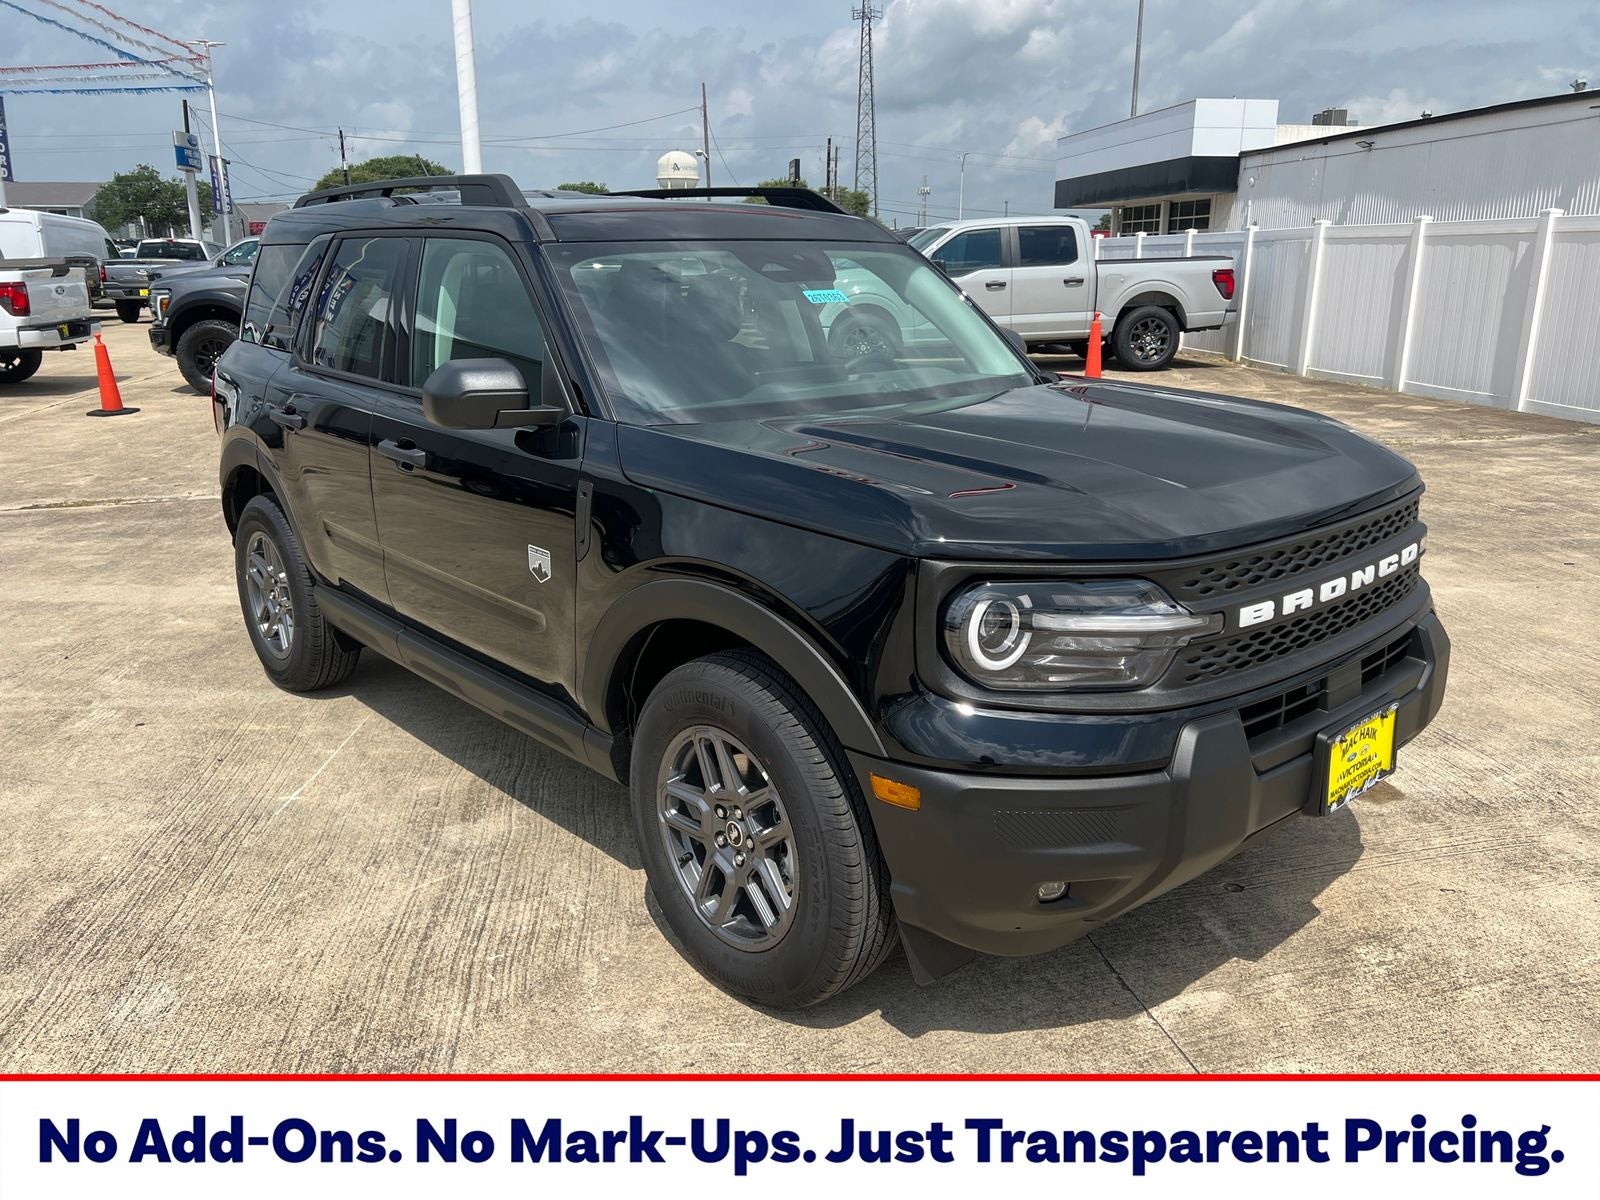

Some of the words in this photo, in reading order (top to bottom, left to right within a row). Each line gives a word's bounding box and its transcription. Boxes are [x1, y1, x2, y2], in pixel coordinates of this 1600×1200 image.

[1238, 543, 1418, 628] BRONCO
[663, 690, 726, 713] Continental
[1341, 732, 1359, 762] MAC
[1360, 728, 1378, 741] HAIK
